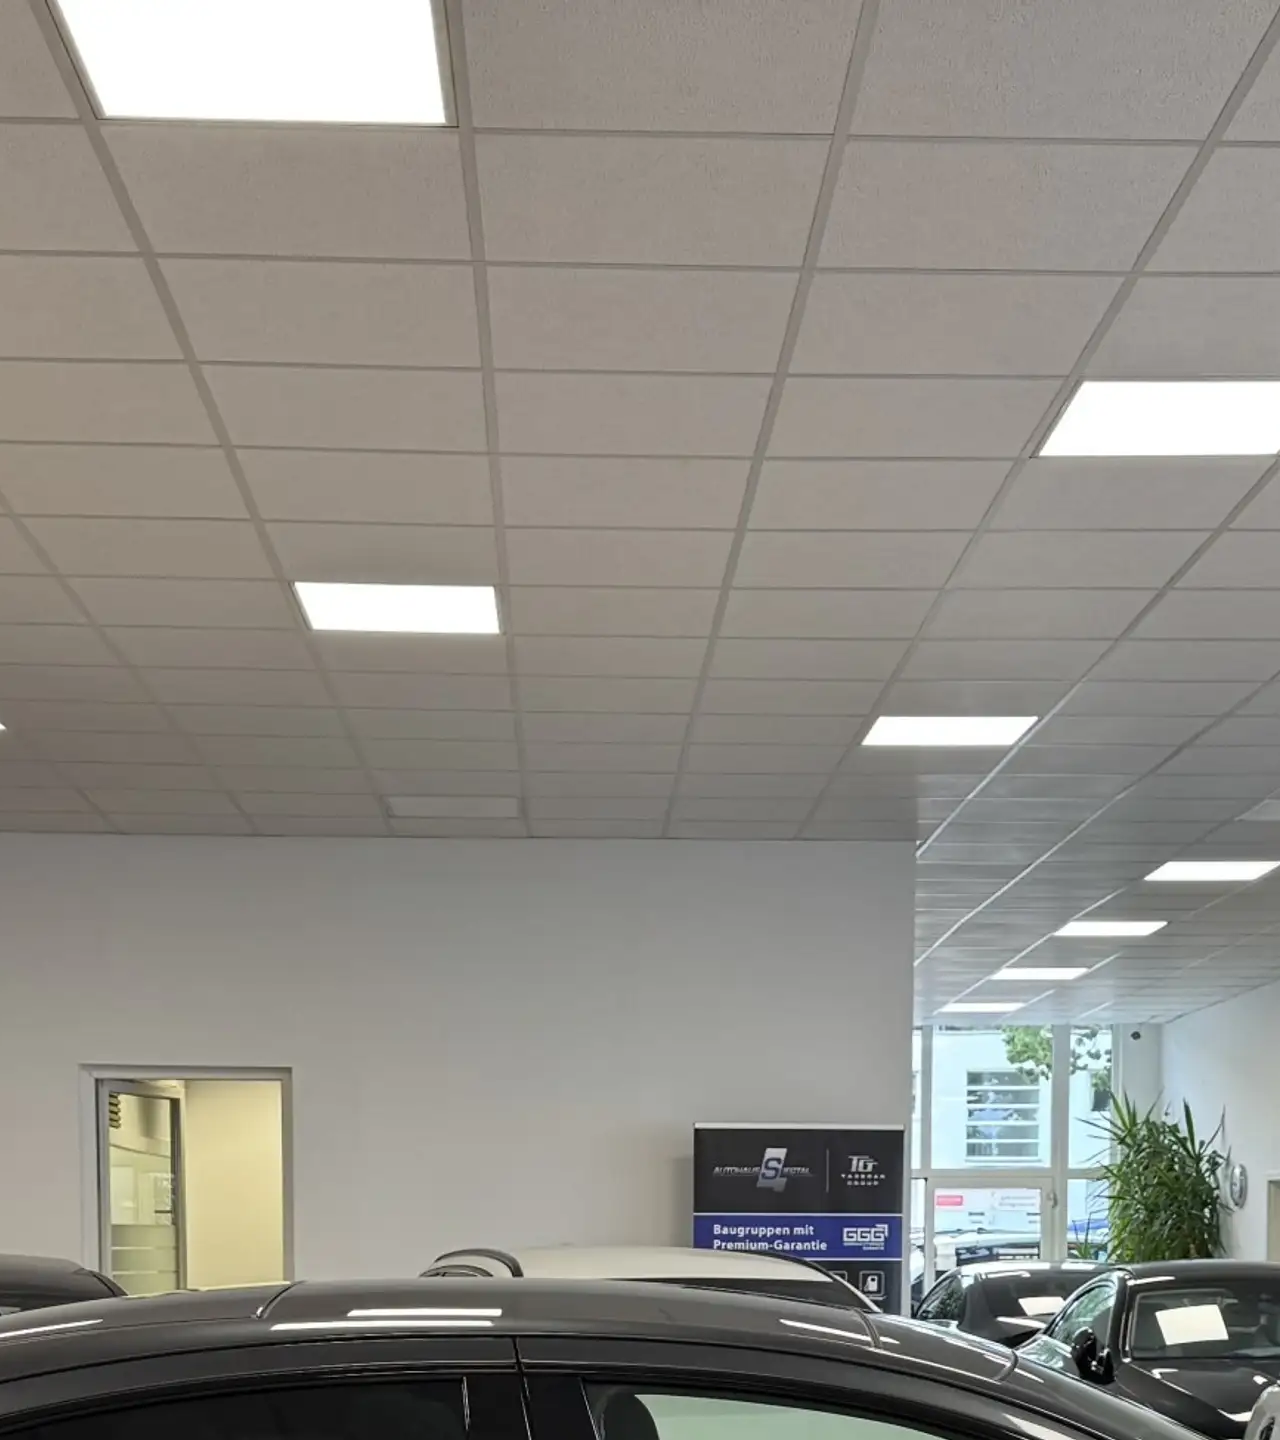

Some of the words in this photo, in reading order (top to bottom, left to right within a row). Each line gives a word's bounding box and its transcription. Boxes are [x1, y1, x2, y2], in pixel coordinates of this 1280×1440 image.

[713, 1224, 790, 1238] Baugruppen
[793, 1224, 815, 1236] mit
[843, 1227, 885, 1242] GGG
[713, 1239, 828, 1251] Premium-Garantie
